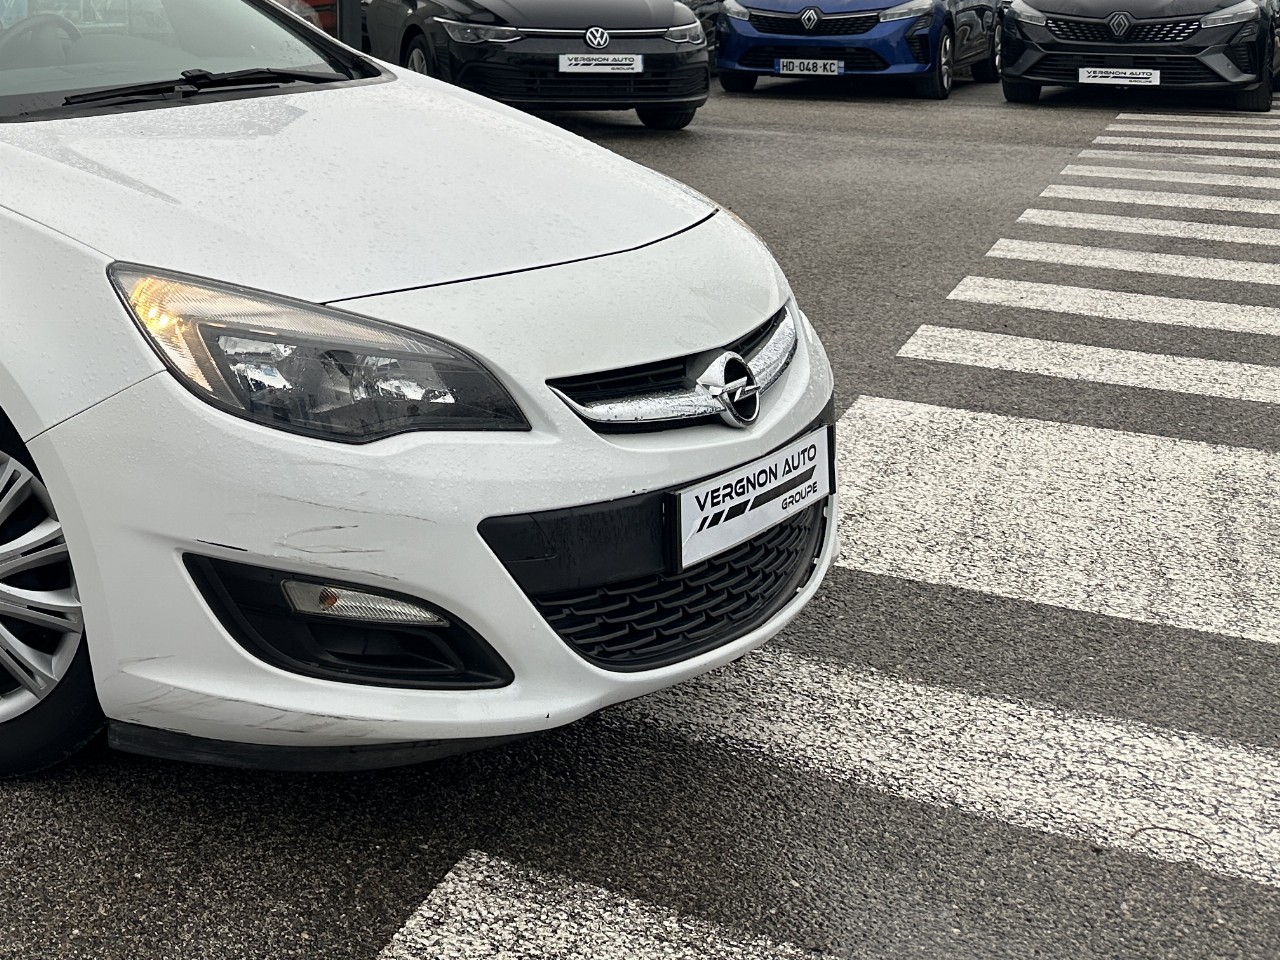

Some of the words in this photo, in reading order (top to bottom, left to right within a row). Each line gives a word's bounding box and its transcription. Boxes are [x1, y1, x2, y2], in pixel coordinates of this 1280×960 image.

[782, 61, 836, 73] HD-048-KC
[694, 463, 778, 512] VERGNON
[781, 443, 817, 477] AUTO
[781, 481, 818, 510] GROUPE
